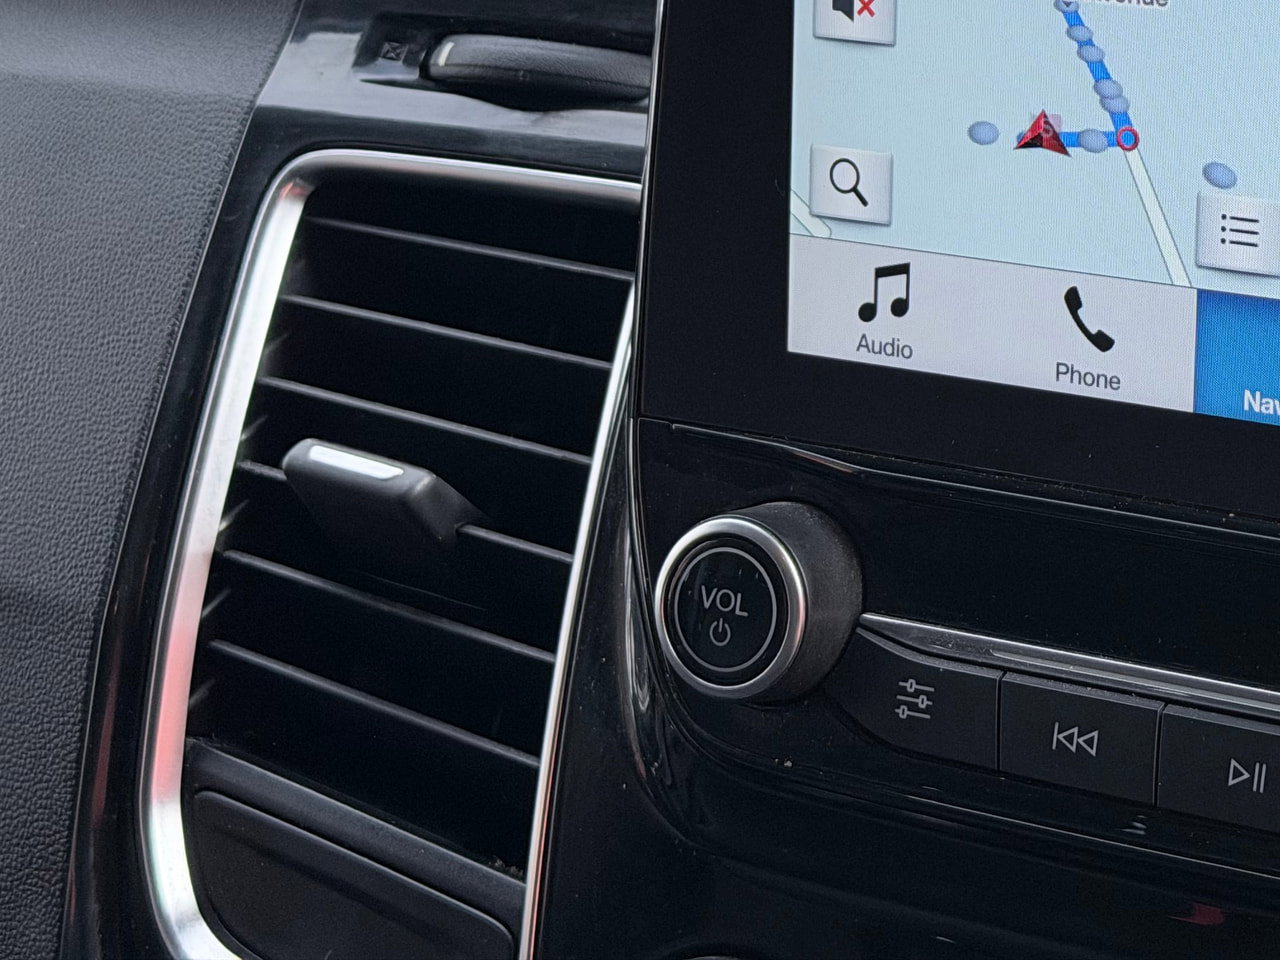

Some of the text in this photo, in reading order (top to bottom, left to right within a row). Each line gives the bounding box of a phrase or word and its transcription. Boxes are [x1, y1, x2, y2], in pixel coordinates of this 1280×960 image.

[855, 333, 914, 360] Audio
[1055, 362, 1122, 392] Phone
[700, 585, 749, 617] VOL
